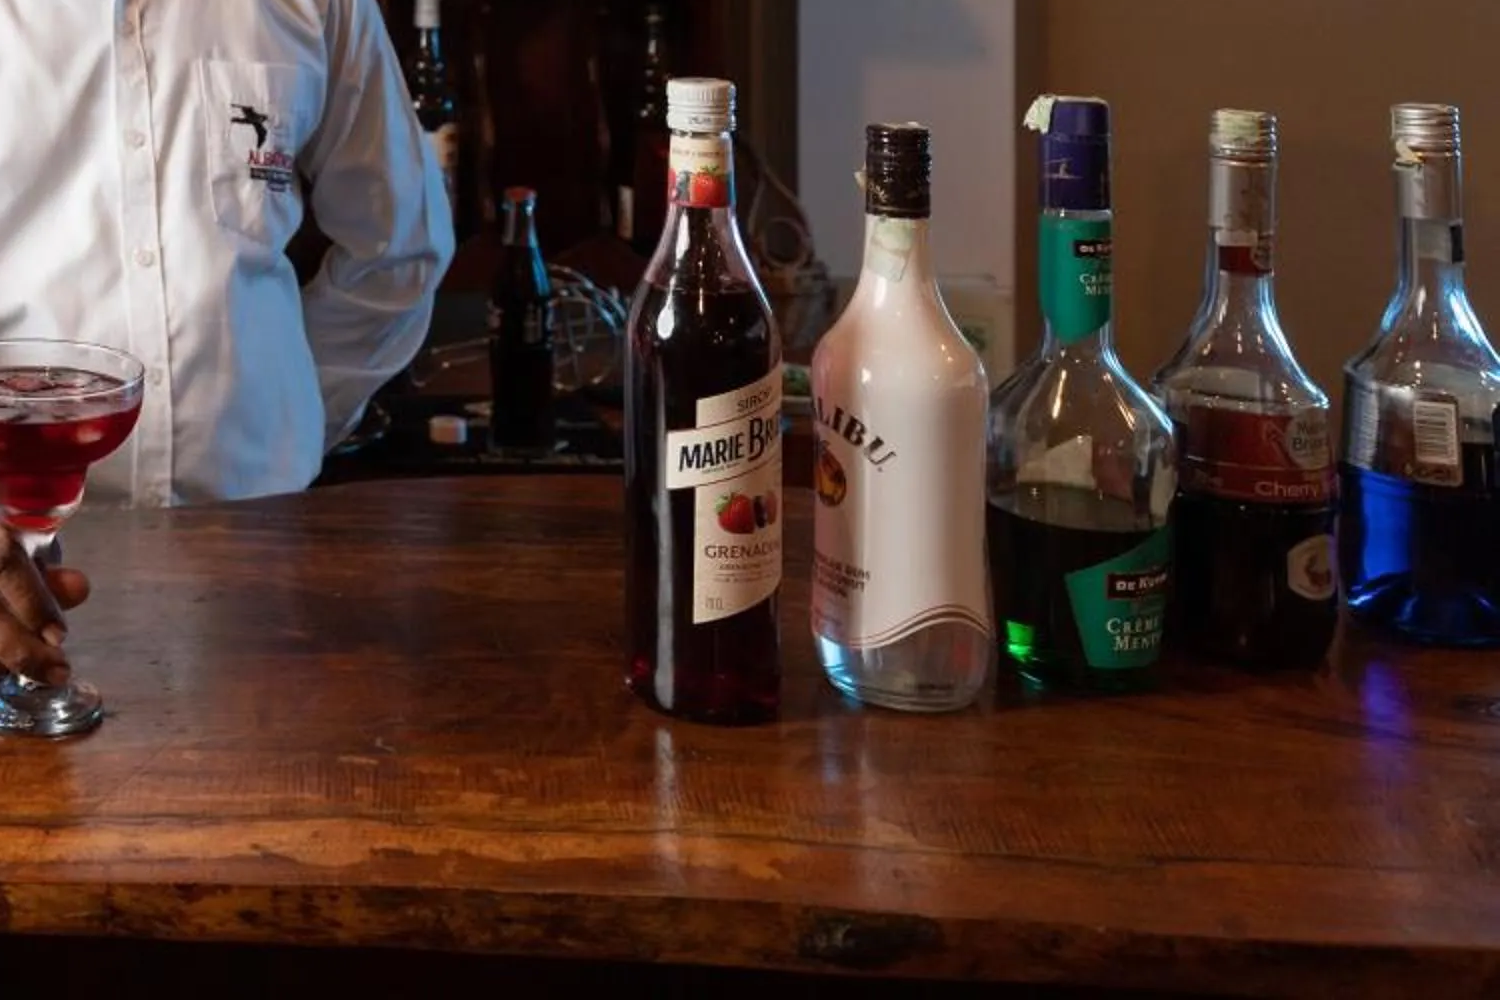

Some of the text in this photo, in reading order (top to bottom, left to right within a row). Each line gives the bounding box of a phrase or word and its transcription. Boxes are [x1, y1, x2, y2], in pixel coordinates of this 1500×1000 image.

[678, 431, 745, 473] MARIE
[816, 395, 897, 467] LIBU
[1254, 480, 1318, 498] Cherry
